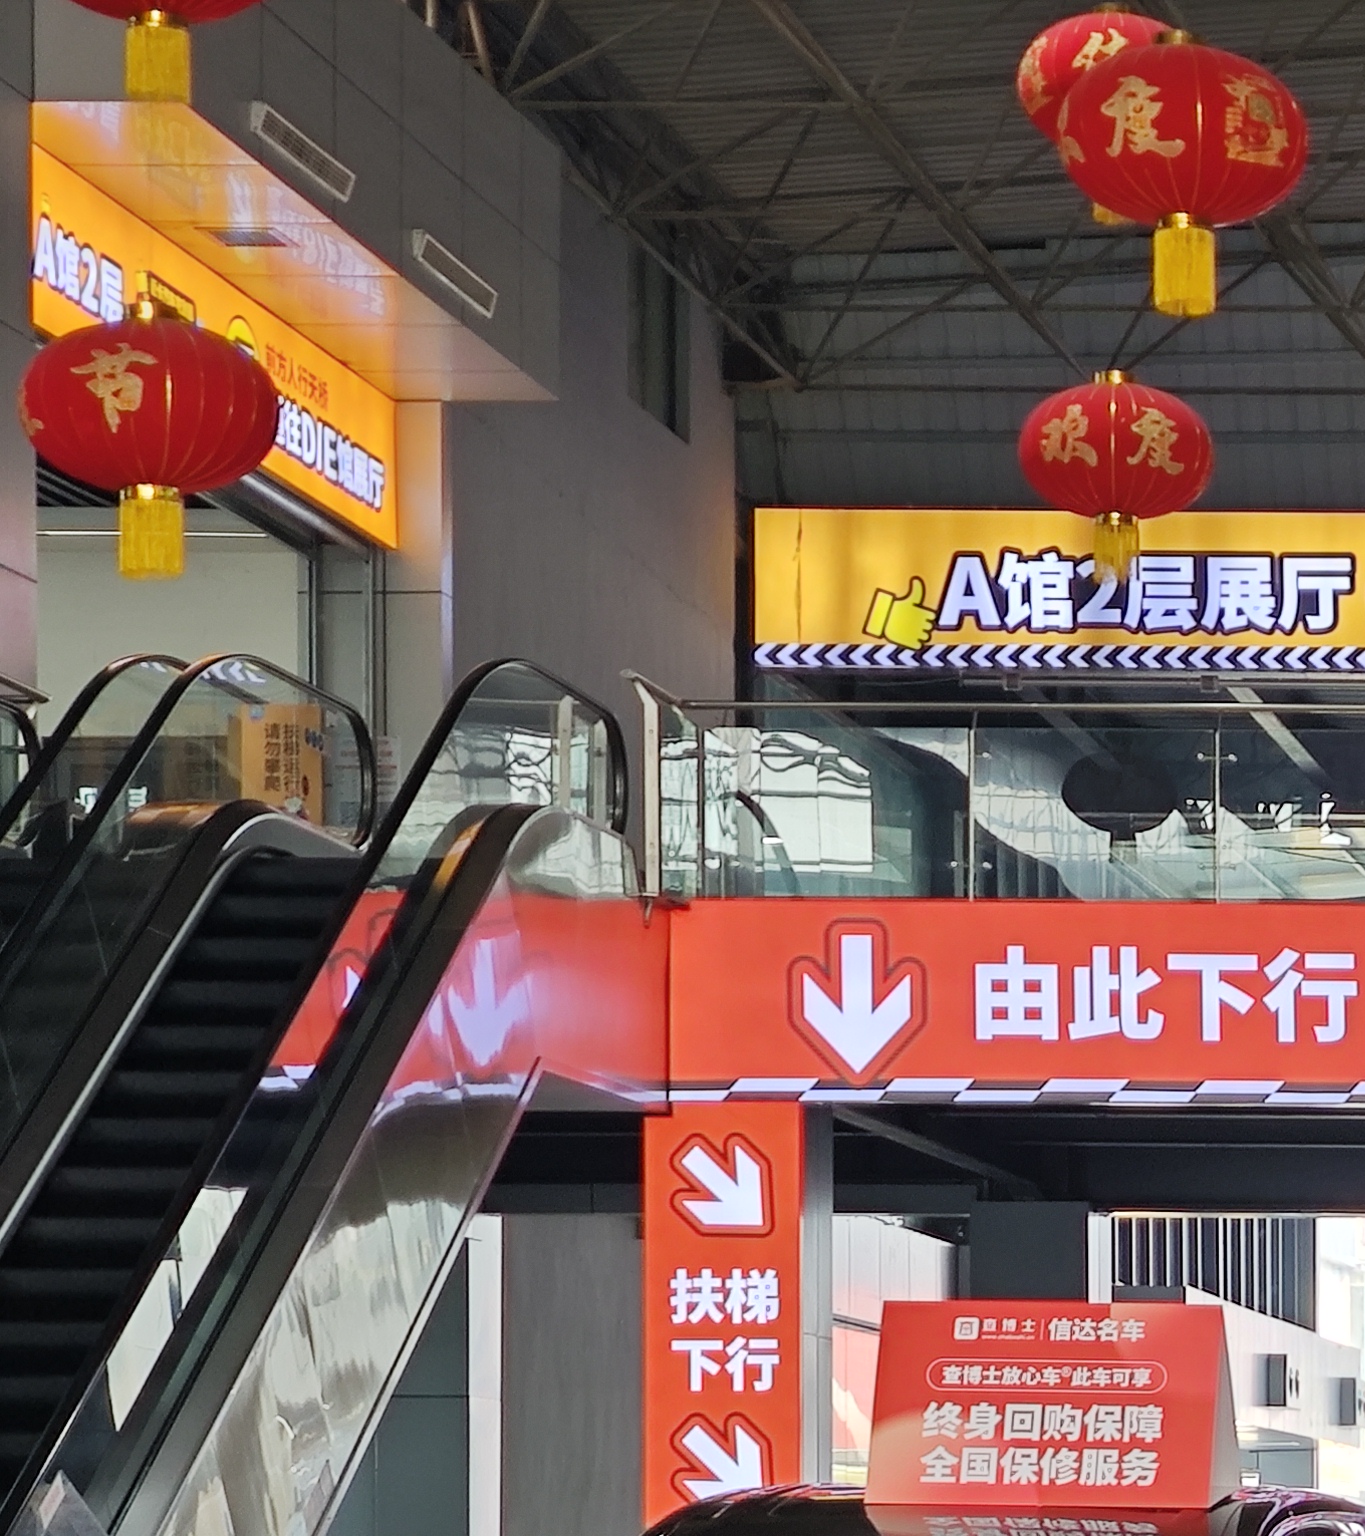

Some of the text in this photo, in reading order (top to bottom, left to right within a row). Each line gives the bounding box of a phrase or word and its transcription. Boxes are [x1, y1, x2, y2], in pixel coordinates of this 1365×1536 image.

[936, 548, 1356, 636] A馆2层展厅
[975, 946, 1359, 1044] 由此下行
[669, 1268, 780, 1325] 扶梯
[1048, 1317, 1146, 1342] 信达名车
[671, 1337, 780, 1393] 下行
[921, 1401, 1164, 1443] 终身回购保障
[919, 1445, 1160, 1487] 全国保修服务
